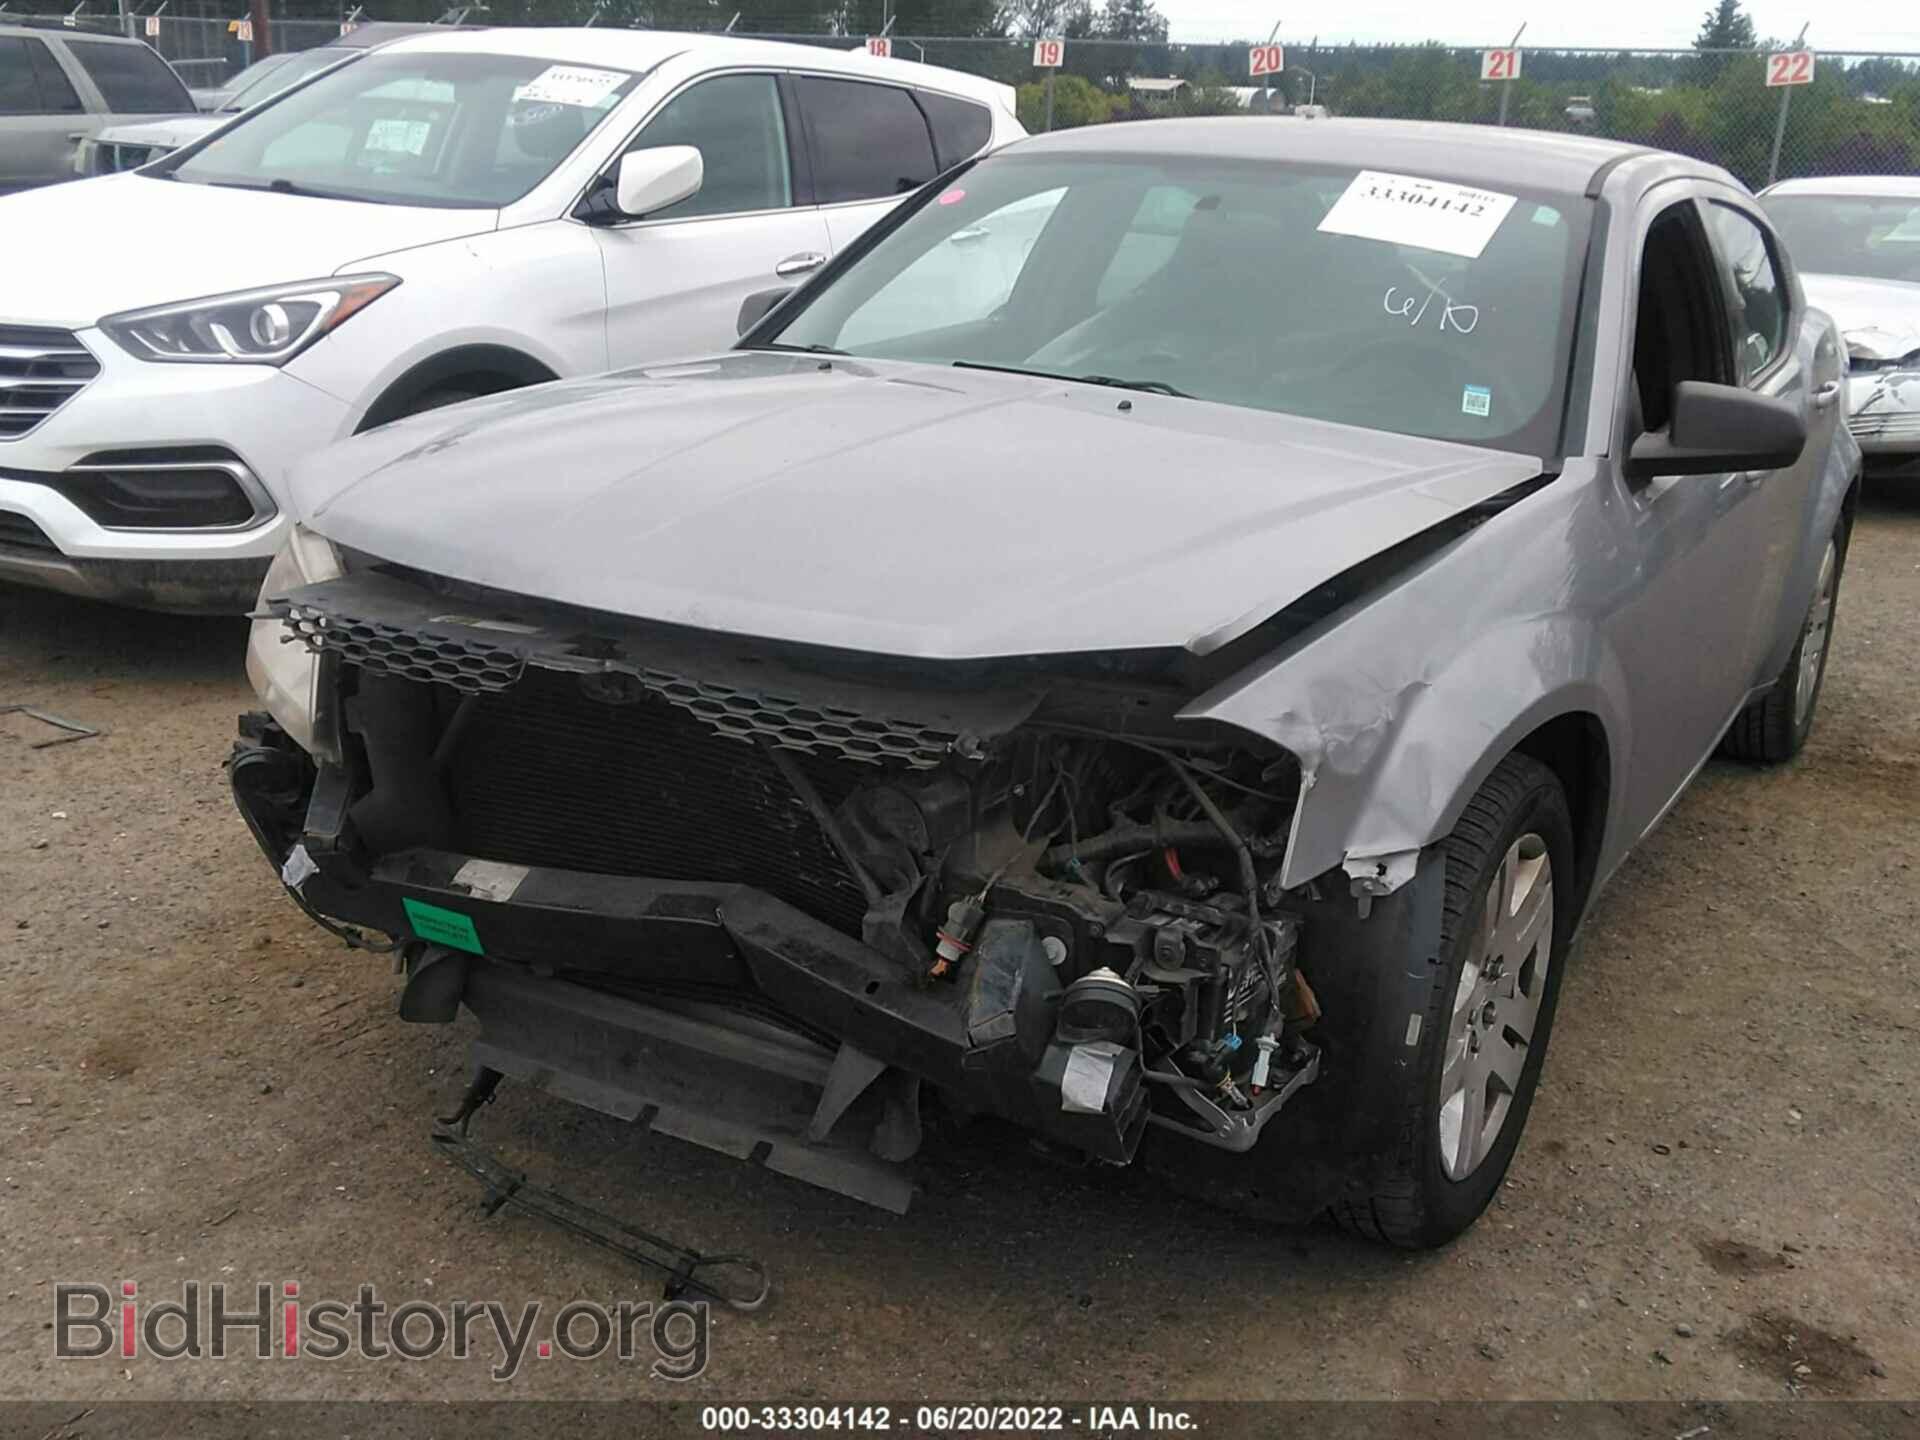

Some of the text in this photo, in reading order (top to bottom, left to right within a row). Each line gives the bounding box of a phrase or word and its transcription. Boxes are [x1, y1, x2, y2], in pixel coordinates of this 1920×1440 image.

[868, 39, 888, 57] 18
[1039, 42, 1060, 65] 19
[1252, 47, 1281, 74] 20
[1487, 50, 1517, 79] 21
[1771, 53, 1811, 83] 22
[1361, 186, 1486, 217] 33304142
